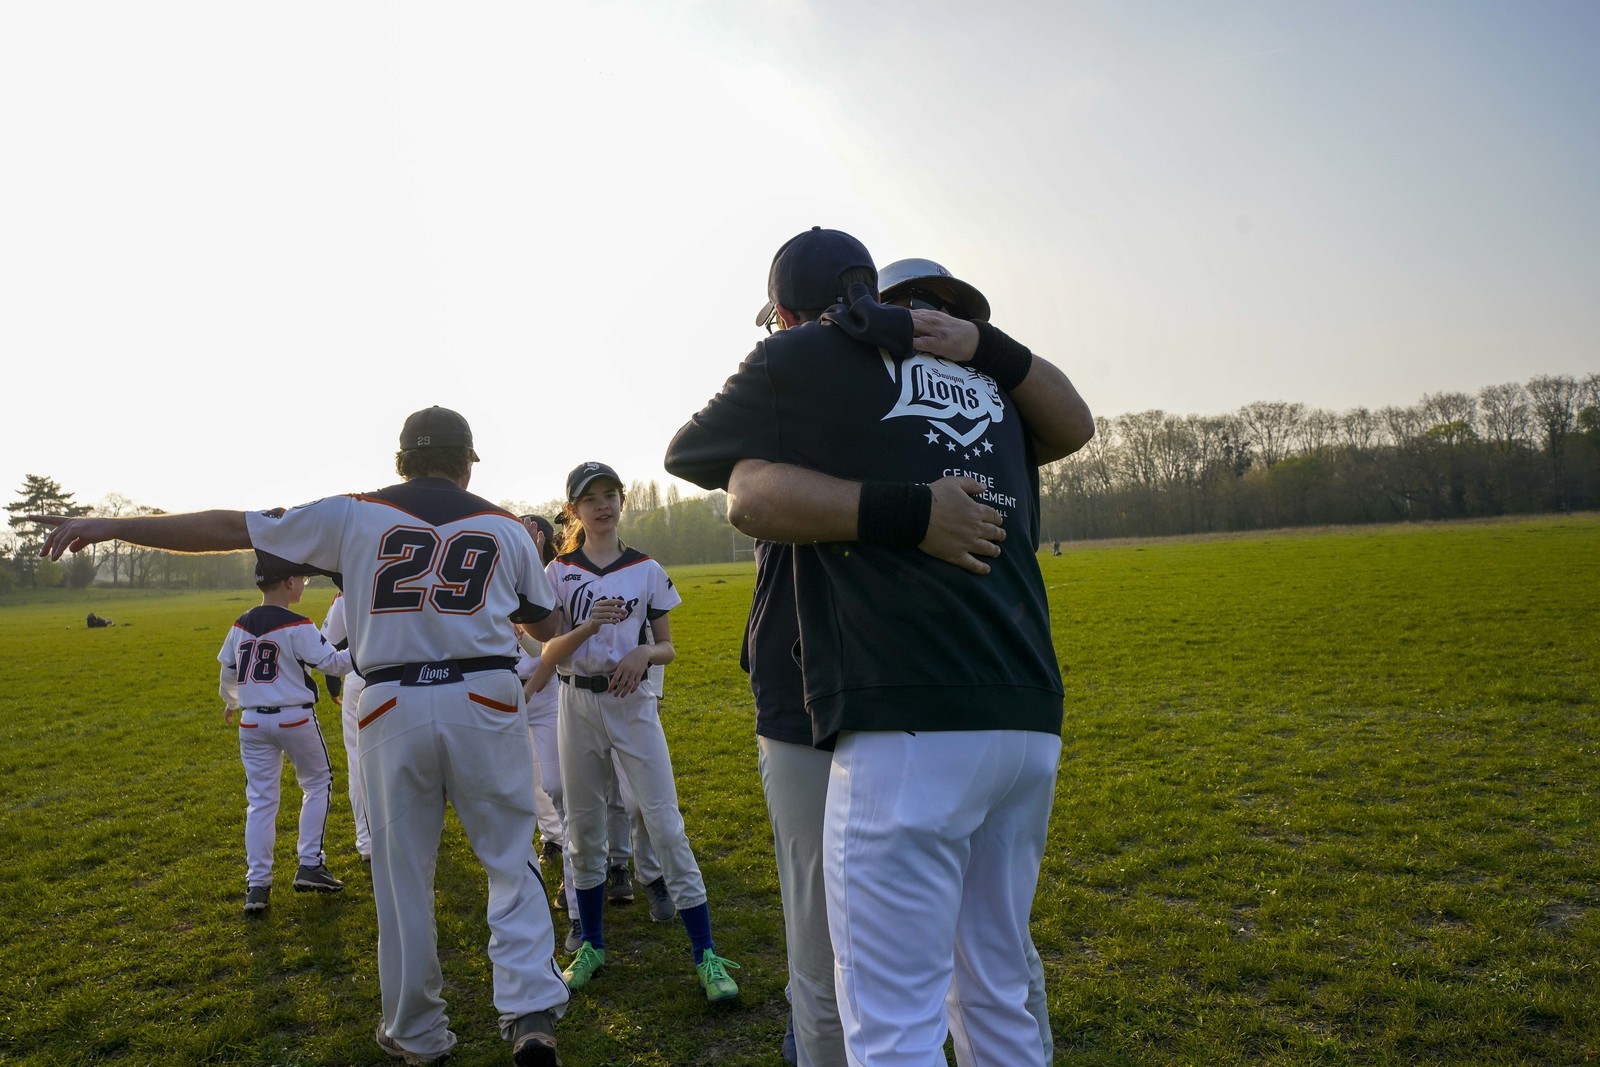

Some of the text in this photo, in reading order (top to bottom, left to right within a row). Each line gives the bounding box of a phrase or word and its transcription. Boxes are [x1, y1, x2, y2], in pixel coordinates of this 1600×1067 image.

[907, 364, 980, 411] Lions
[417, 436, 431, 446] 29
[942, 468, 995, 489] CENTRE
[370, 524, 500, 616] 29
[571, 579, 639, 630] Lis
[237, 639, 281, 686] 18
[416, 663, 450, 684] Lions
